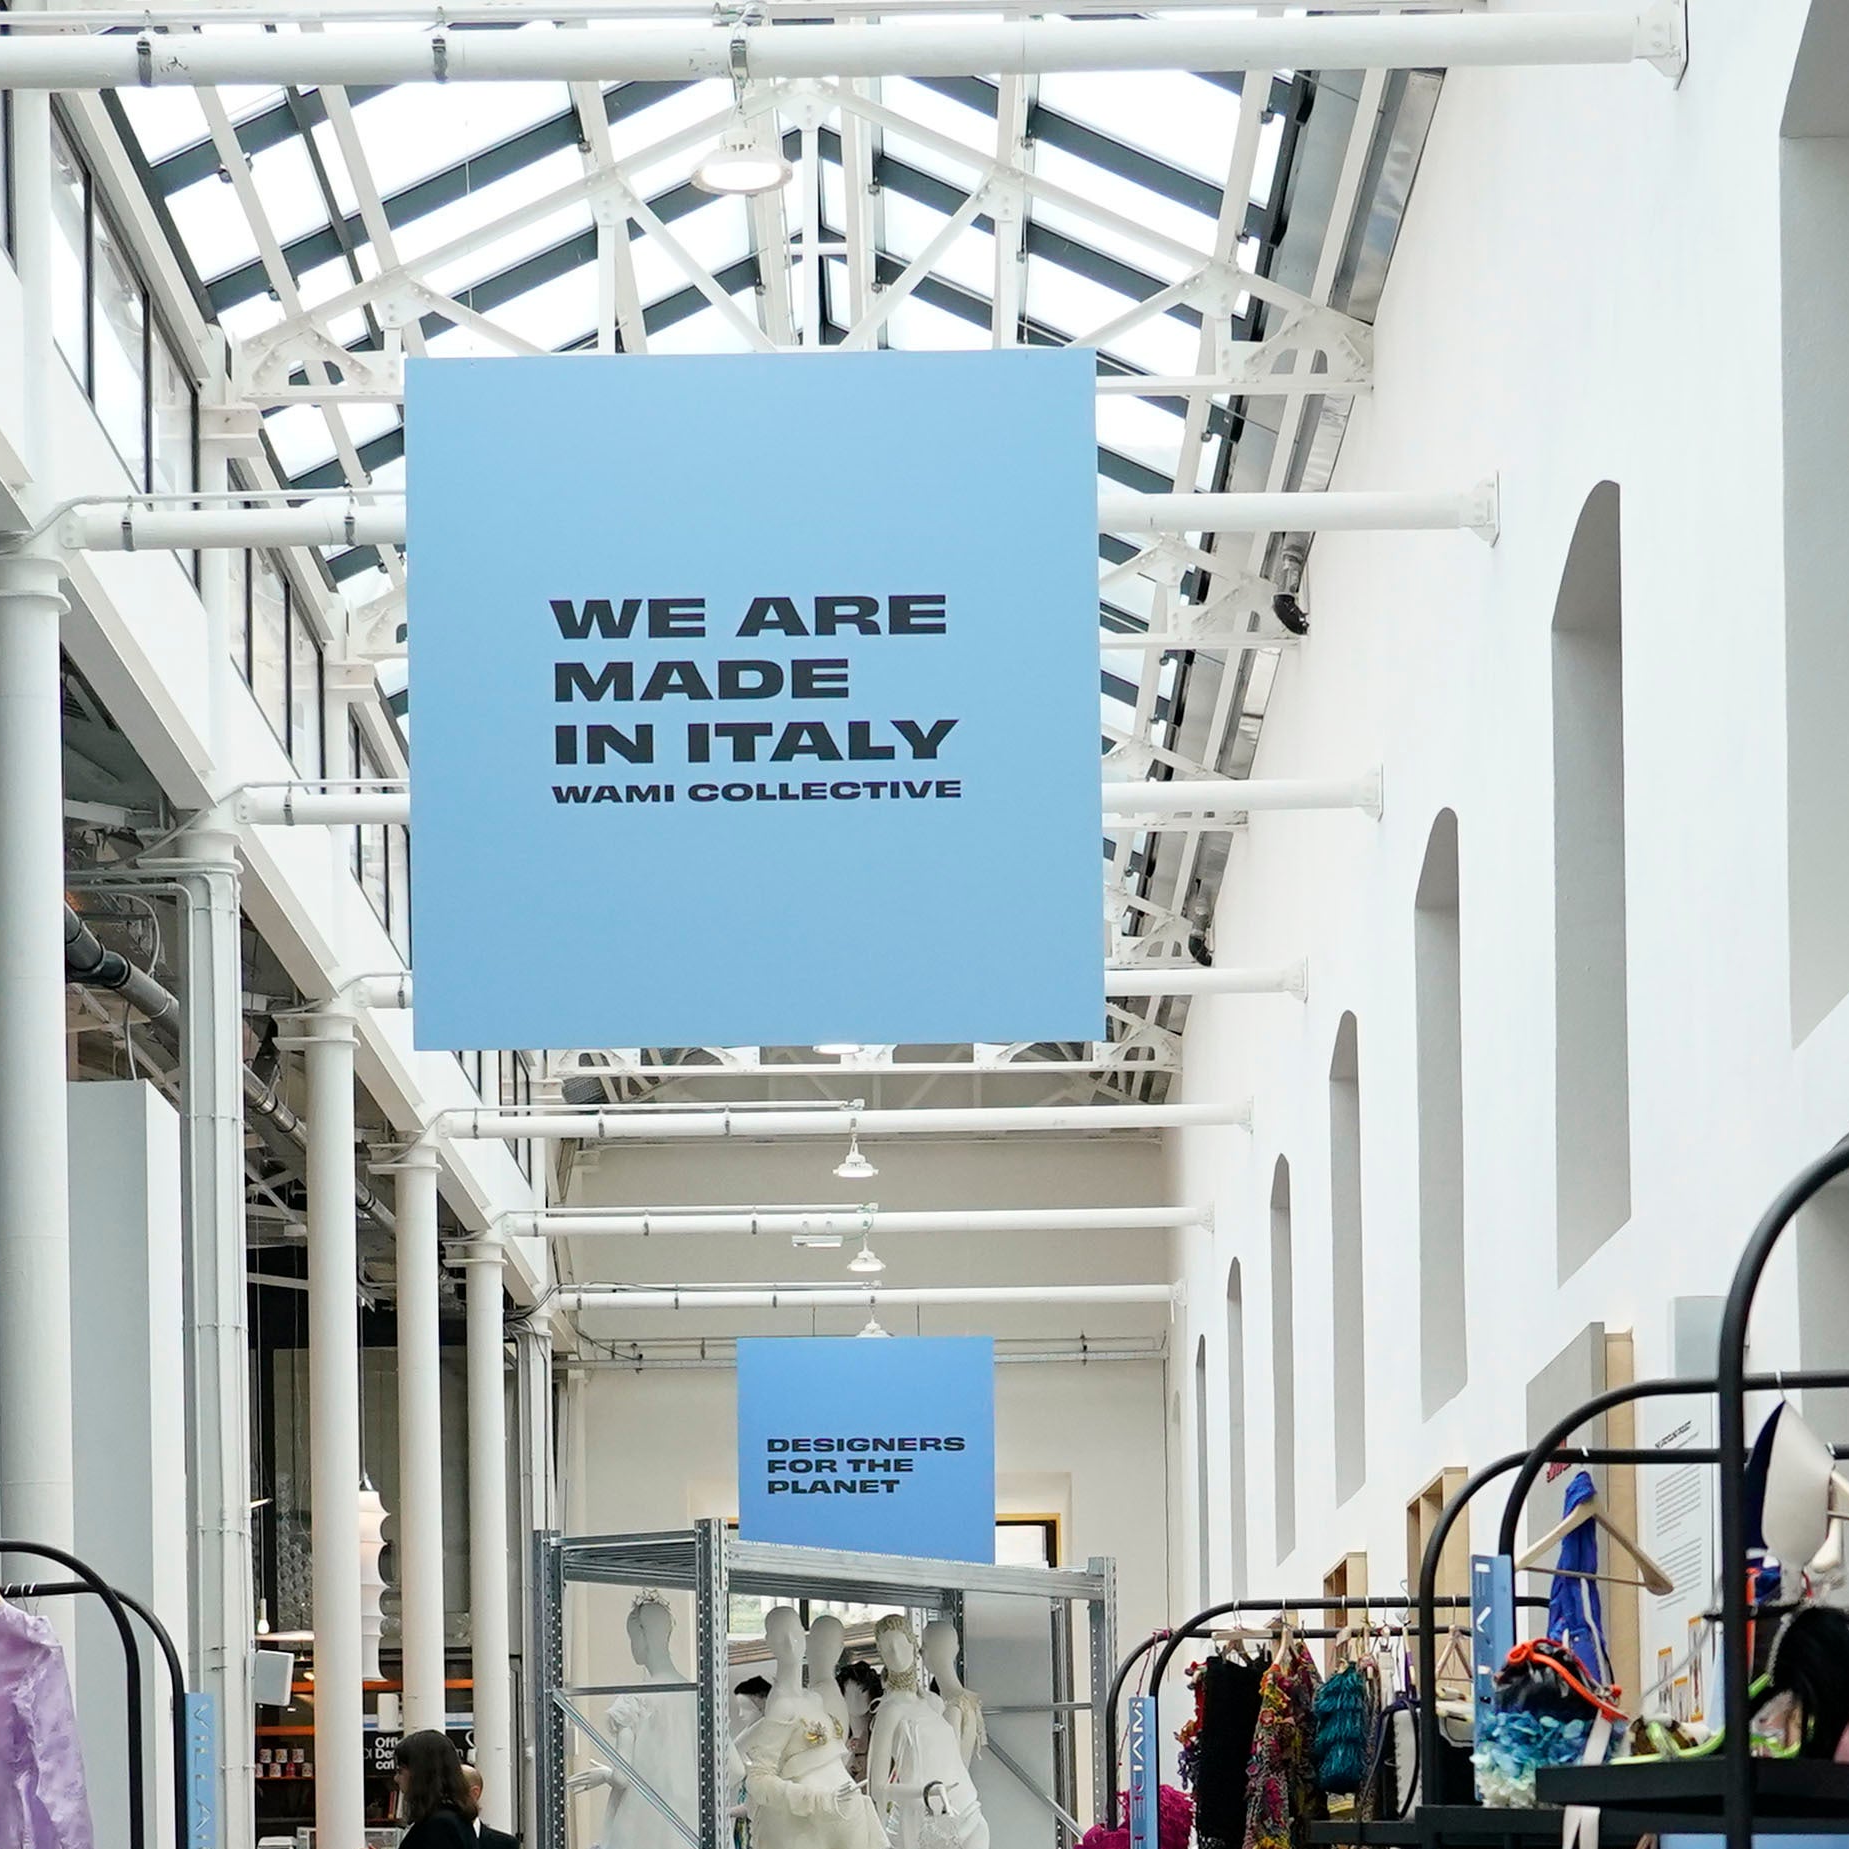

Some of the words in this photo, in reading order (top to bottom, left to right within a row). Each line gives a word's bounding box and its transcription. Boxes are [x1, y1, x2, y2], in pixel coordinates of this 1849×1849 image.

[549, 597, 707, 640] WE
[735, 594, 947, 637] ARE
[554, 658, 849, 702] MADE
[555, 723, 653, 765] IN
[688, 719, 960, 764] ITALY
[552, 783, 675, 804] WAMI
[688, 779, 962, 801] COLLECTIVE
[767, 1436, 965, 1453] DESIGNERS
[767, 1458, 837, 1474] FOR
[847, 1458, 914, 1473] THE
[767, 1479, 901, 1495] PLANET
